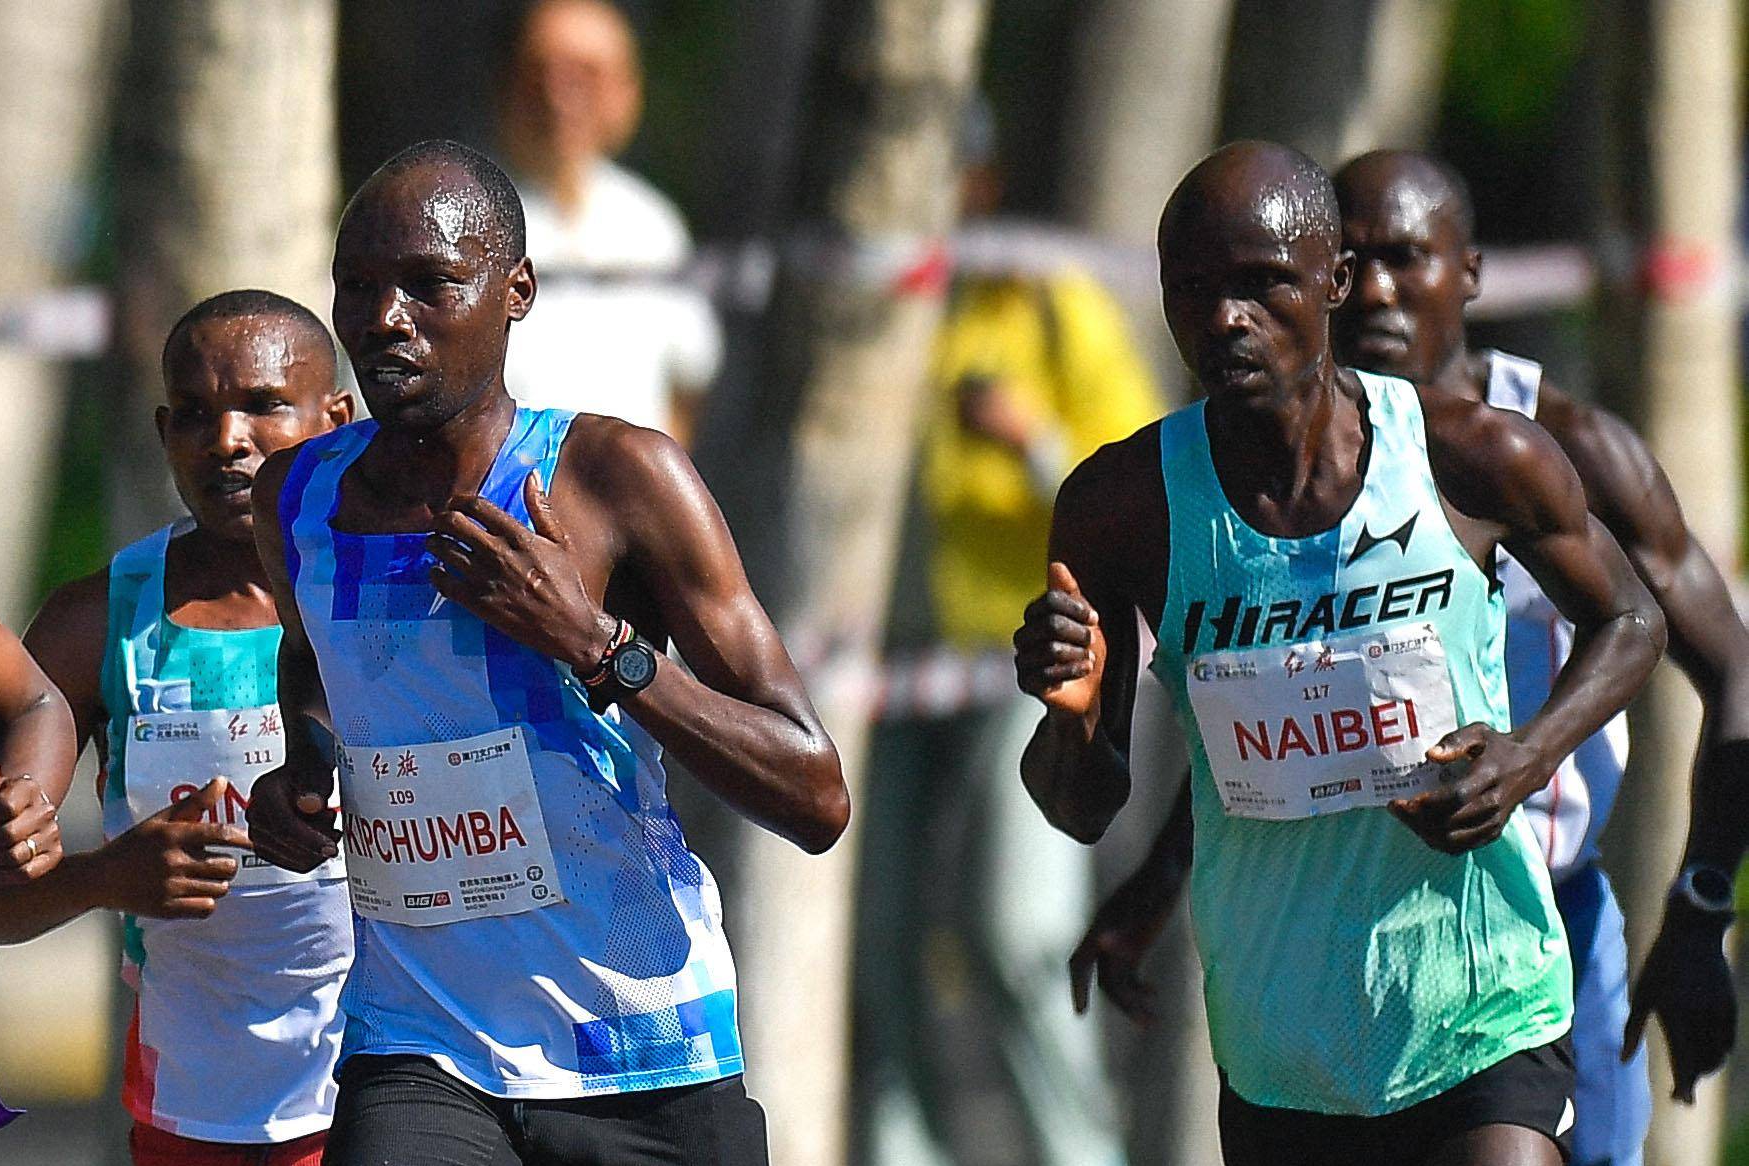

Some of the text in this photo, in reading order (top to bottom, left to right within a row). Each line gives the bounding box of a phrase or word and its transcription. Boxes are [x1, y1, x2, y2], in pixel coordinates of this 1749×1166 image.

[1183, 568, 1454, 656] HIRACER
[228, 709, 281, 742] 红旗
[1233, 698, 1420, 762] NAIBEI
[244, 750, 272, 765] 111
[371, 749, 419, 781] 红旗
[389, 790, 415, 805] 109
[407, 896, 431, 906] BIG
